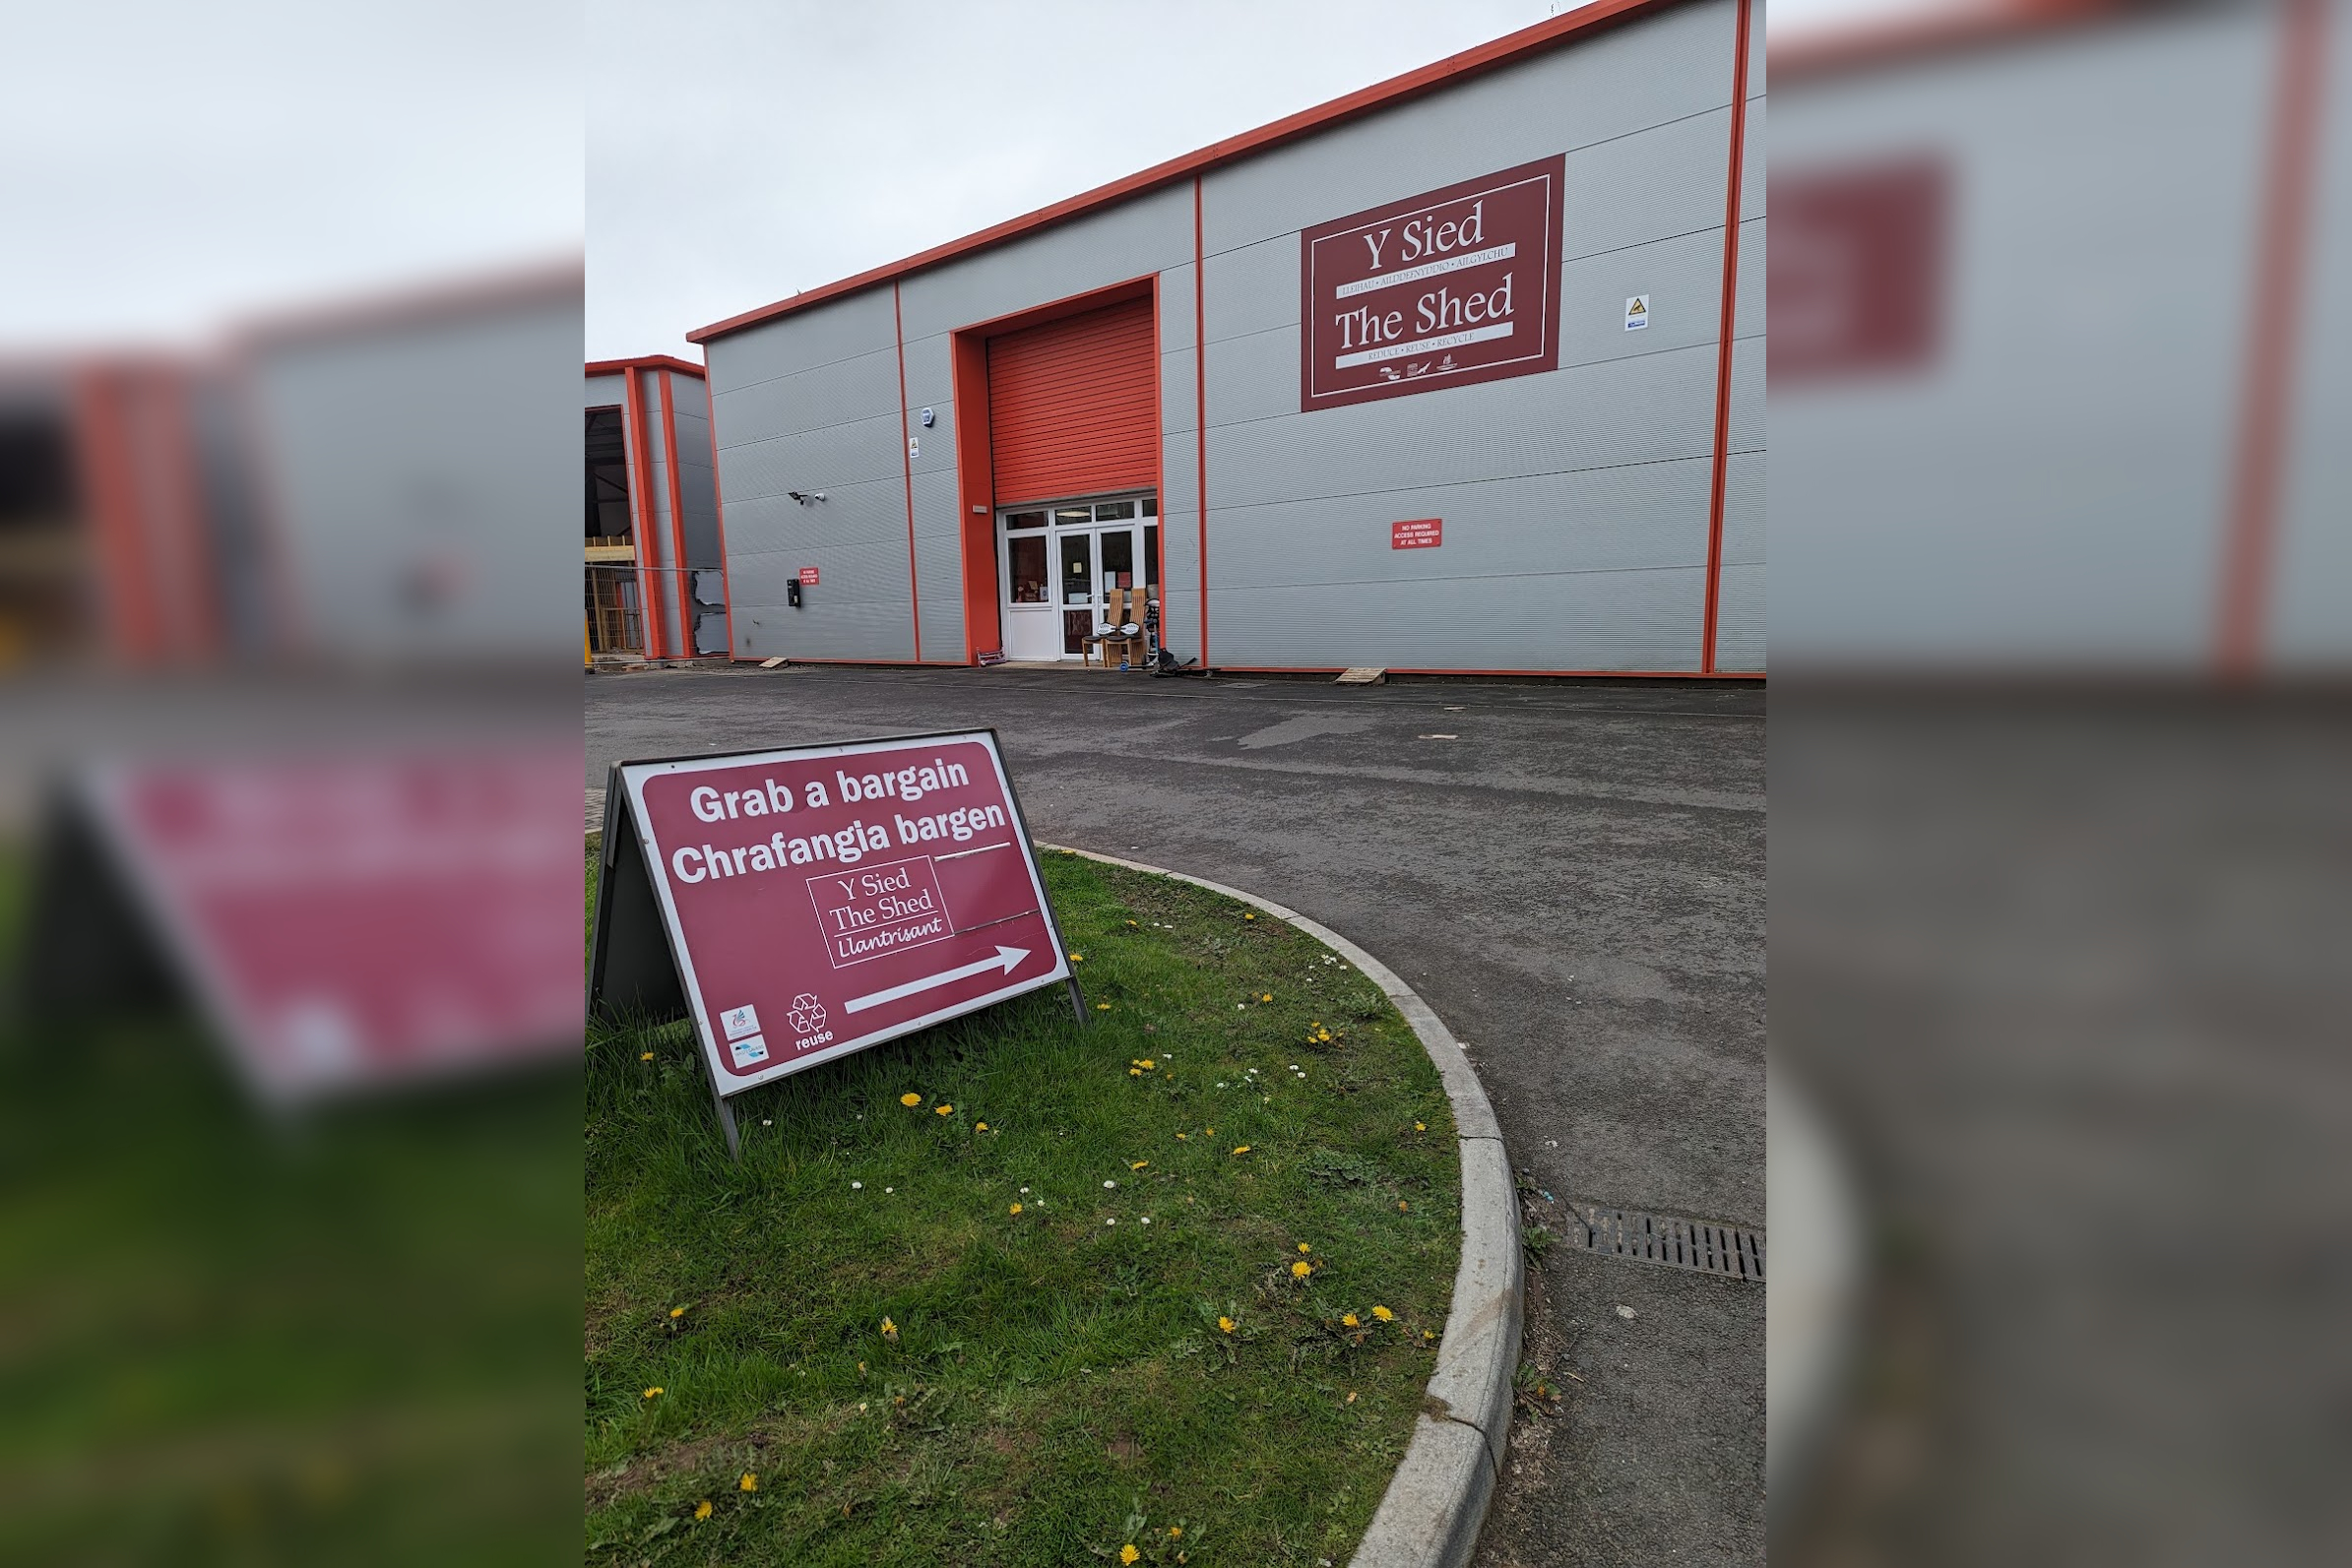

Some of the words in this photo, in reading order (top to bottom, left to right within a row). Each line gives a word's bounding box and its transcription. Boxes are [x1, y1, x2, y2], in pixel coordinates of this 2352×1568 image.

[1363, 228, 1391, 271] Y
[1401, 199, 1485, 262] Sied
[1342, 280, 1375, 295] LLEIHAU
[1380, 262, 1450, 285] AILDDEFNYDDIO
[1456, 247, 1508, 267] AILGYLCHU
[1335, 305, 1403, 349] The
[1416, 272, 1514, 334] Shed
[1368, 346, 1400, 360] REDUCE
[1406, 341, 1431, 354] REUSE
[1437, 332, 1475, 347] RECYCLE
[690, 779, 794, 823] Grab
[805, 779, 829, 809] a
[836, 757, 970, 803] bargain
[671, 819, 890, 885] Chrafangia
[894, 803, 1006, 845] bargen
[837, 878, 857, 901] Y
[861, 866, 912, 896] Sied
[828, 903, 877, 931] The
[878, 888, 934, 919] Shed
[837, 917, 943, 958] Llantrisant
[795, 1029, 835, 1051] reuse
